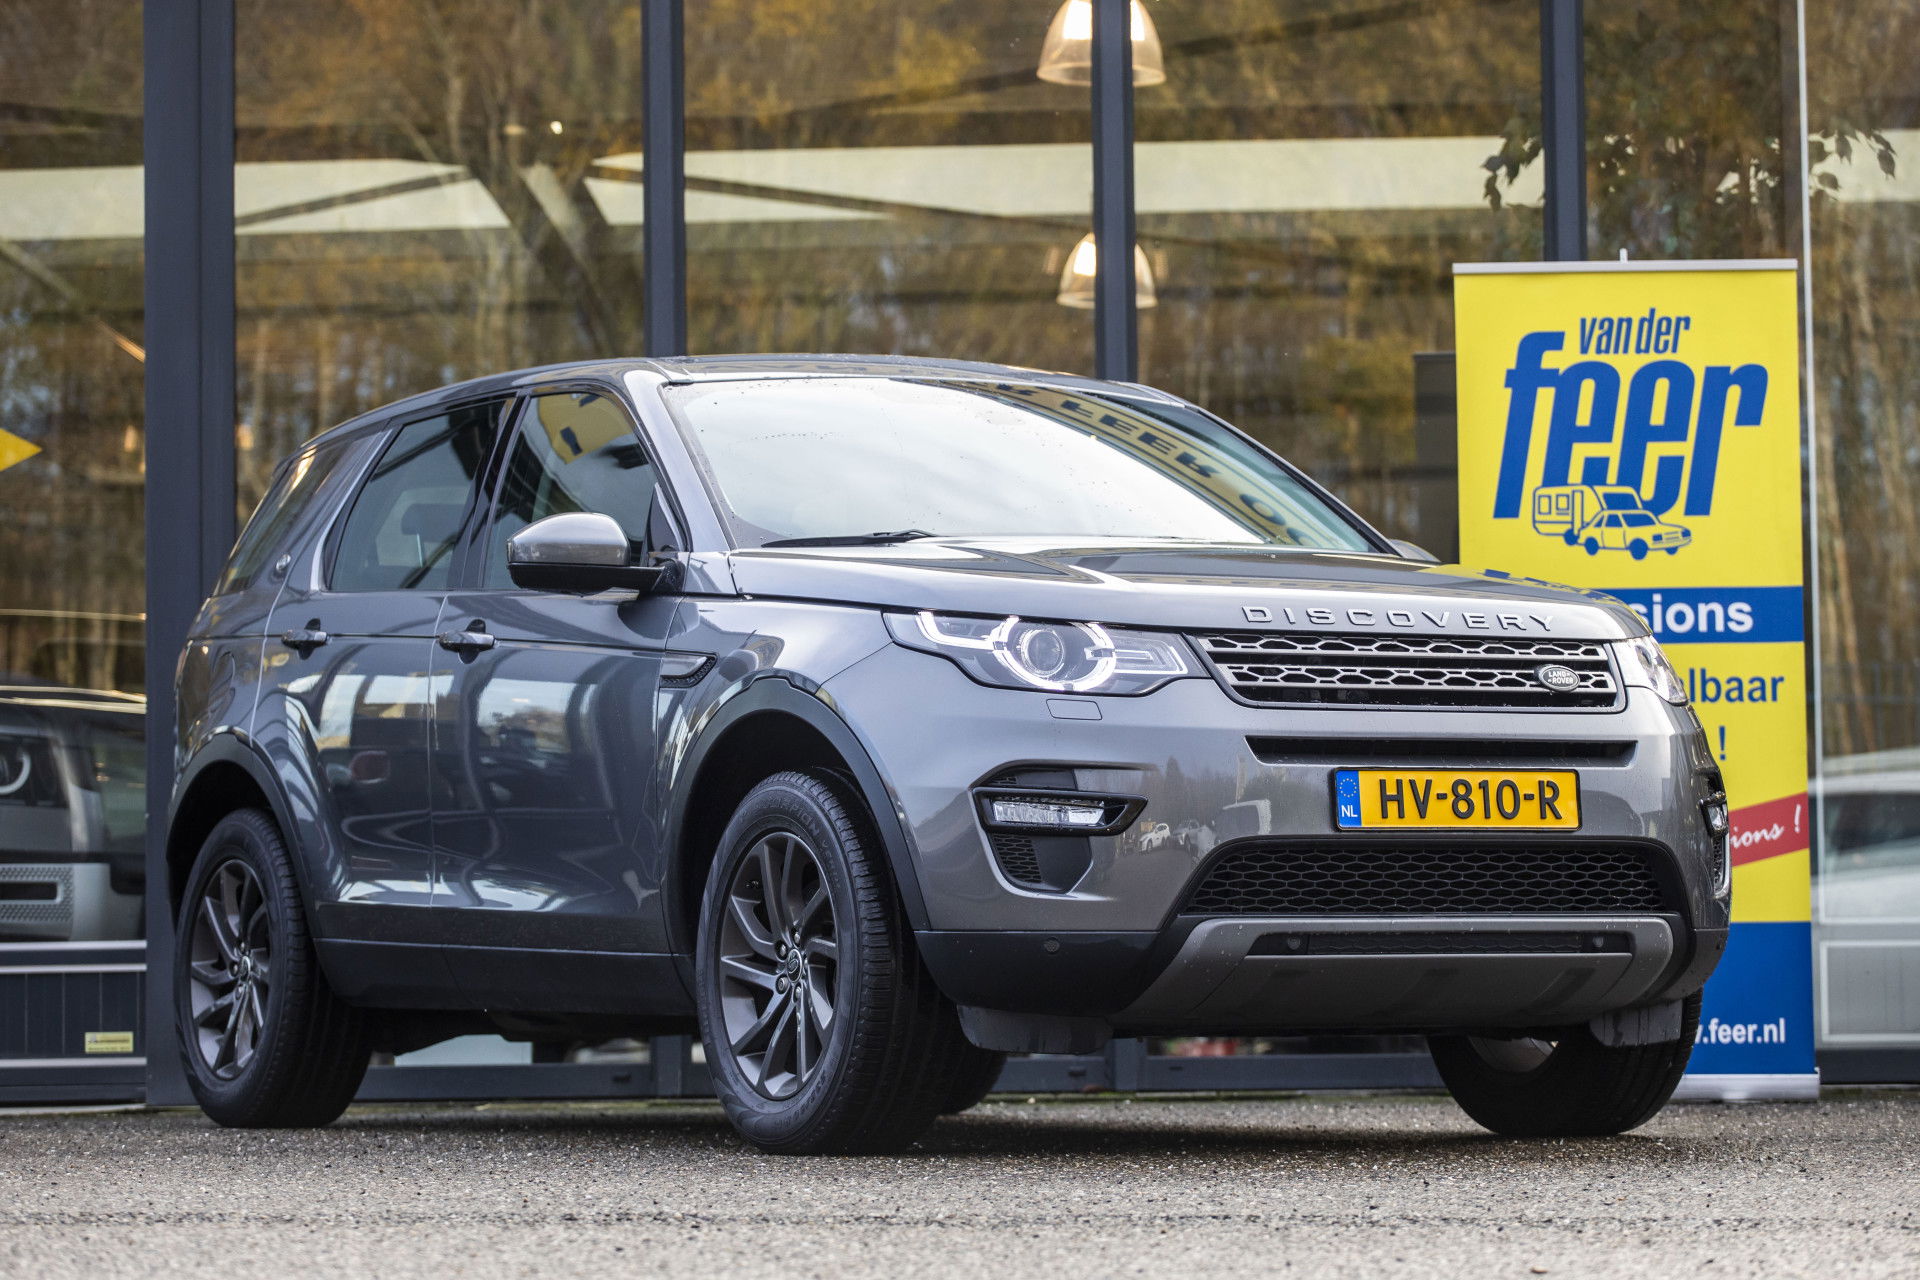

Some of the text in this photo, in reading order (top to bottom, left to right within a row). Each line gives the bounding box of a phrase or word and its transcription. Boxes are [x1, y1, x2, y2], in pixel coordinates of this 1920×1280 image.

[1580, 307, 1691, 355] van der
[1493, 331, 1769, 519] feer
[1242, 606, 1554, 632] DISCOVERY
[1548, 670, 1567, 678] LAND
[1680, 667, 1784, 702] lbaar
[1718, 725, 1727, 761] !
[1341, 804, 1358, 818] NL
[1379, 778, 1563, 820] HV-810-R
[1695, 1017, 1786, 1044] .feer.nl
